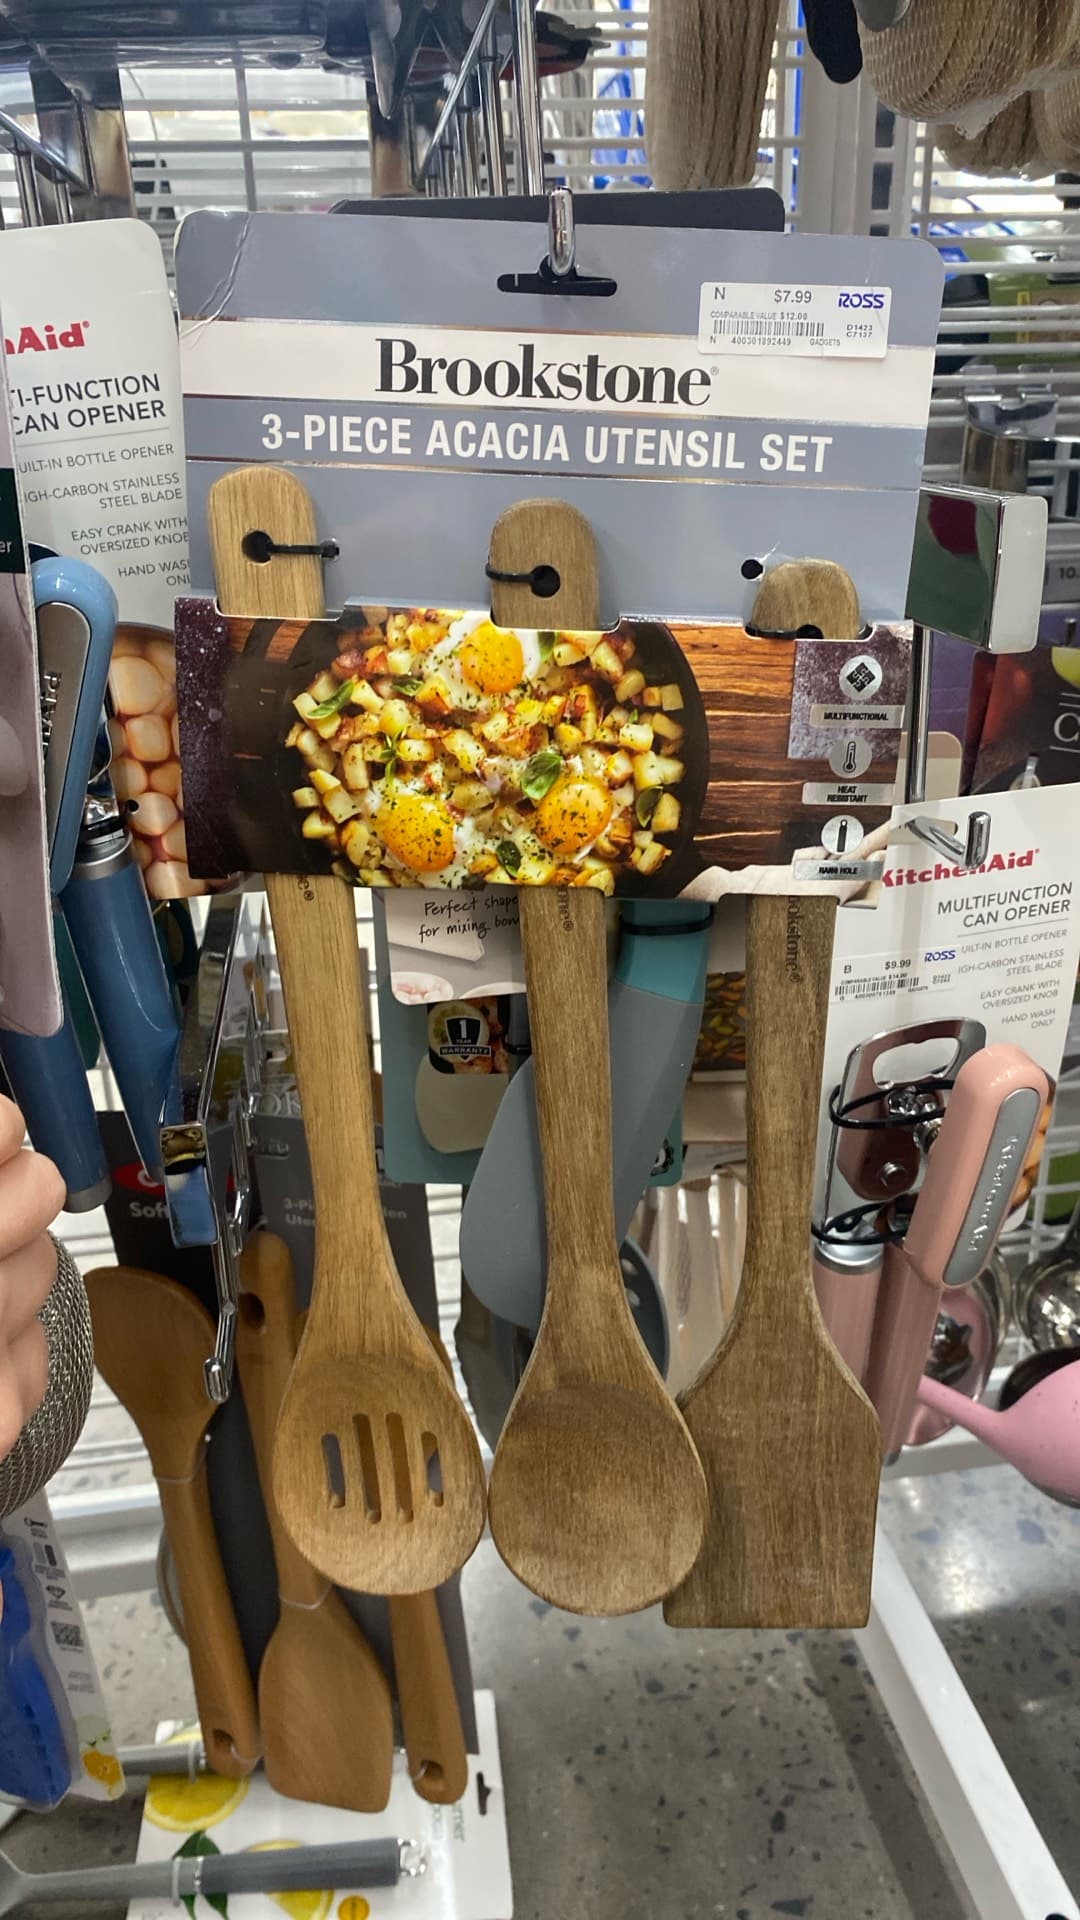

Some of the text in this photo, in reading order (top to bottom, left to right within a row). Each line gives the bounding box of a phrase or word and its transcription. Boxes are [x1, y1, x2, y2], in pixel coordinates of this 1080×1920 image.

[714, 287, 726, 300] N
[774, 289, 812, 305] $7.99
[838, 293, 885, 309] ROSS
[710, 311, 755, 320] COMPARABLE
[756, 312, 777, 320] VALUE
[710, 336, 717, 344] N
[809, 338, 841, 346] GADGETS
[10, 373, 161, 407] I-FUNCTION
[67, 400, 166, 428] OPENER
[261, 413, 834, 474] 3-PIECE ACACIA UTENSIL SET
[67, 451, 118, 468] BOTTLE
[121, 443, 175, 460] OPENER
[114, 472, 180, 492] STAINLESS
[99, 488, 183, 509] STEEL BLADE
[71, 517, 188, 541] EASY CRANK WITH
[80, 537, 150, 555] OVERSIZED
[118, 559, 190, 578] HAND WAS
[823, 711, 889, 721] MULTIFUNCTIONAL
[827, 794, 868, 803] RESISTANT
[837, 785, 857, 794] HEAT
[937, 881, 1073, 915] MULTIFUNCTION
[424, 896, 478, 919] Perfect
[963, 899, 1071, 928] CAN OPENER
[419, 923, 440, 943] for
[446, 918, 491, 940] mixing
[994, 935, 1029, 949] BOTTLE
[1031, 929, 1068, 942] OPENER
[924, 950, 956, 962] ROSS
[1018, 949, 1065, 964] STAINLESS
[843, 959, 911, 974] B $9.99
[1006, 960, 1063, 977] STEEL BLADE
[980, 979, 1060, 1000] EASY CRANK WITH
[982, 989, 1058, 1010] OVERSIZED KNOB
[1001, 1008, 1056, 1025] HAND WASH
[1031, 1018, 1055, 1029] ONLY
[459, 1019, 467, 1039] 1
